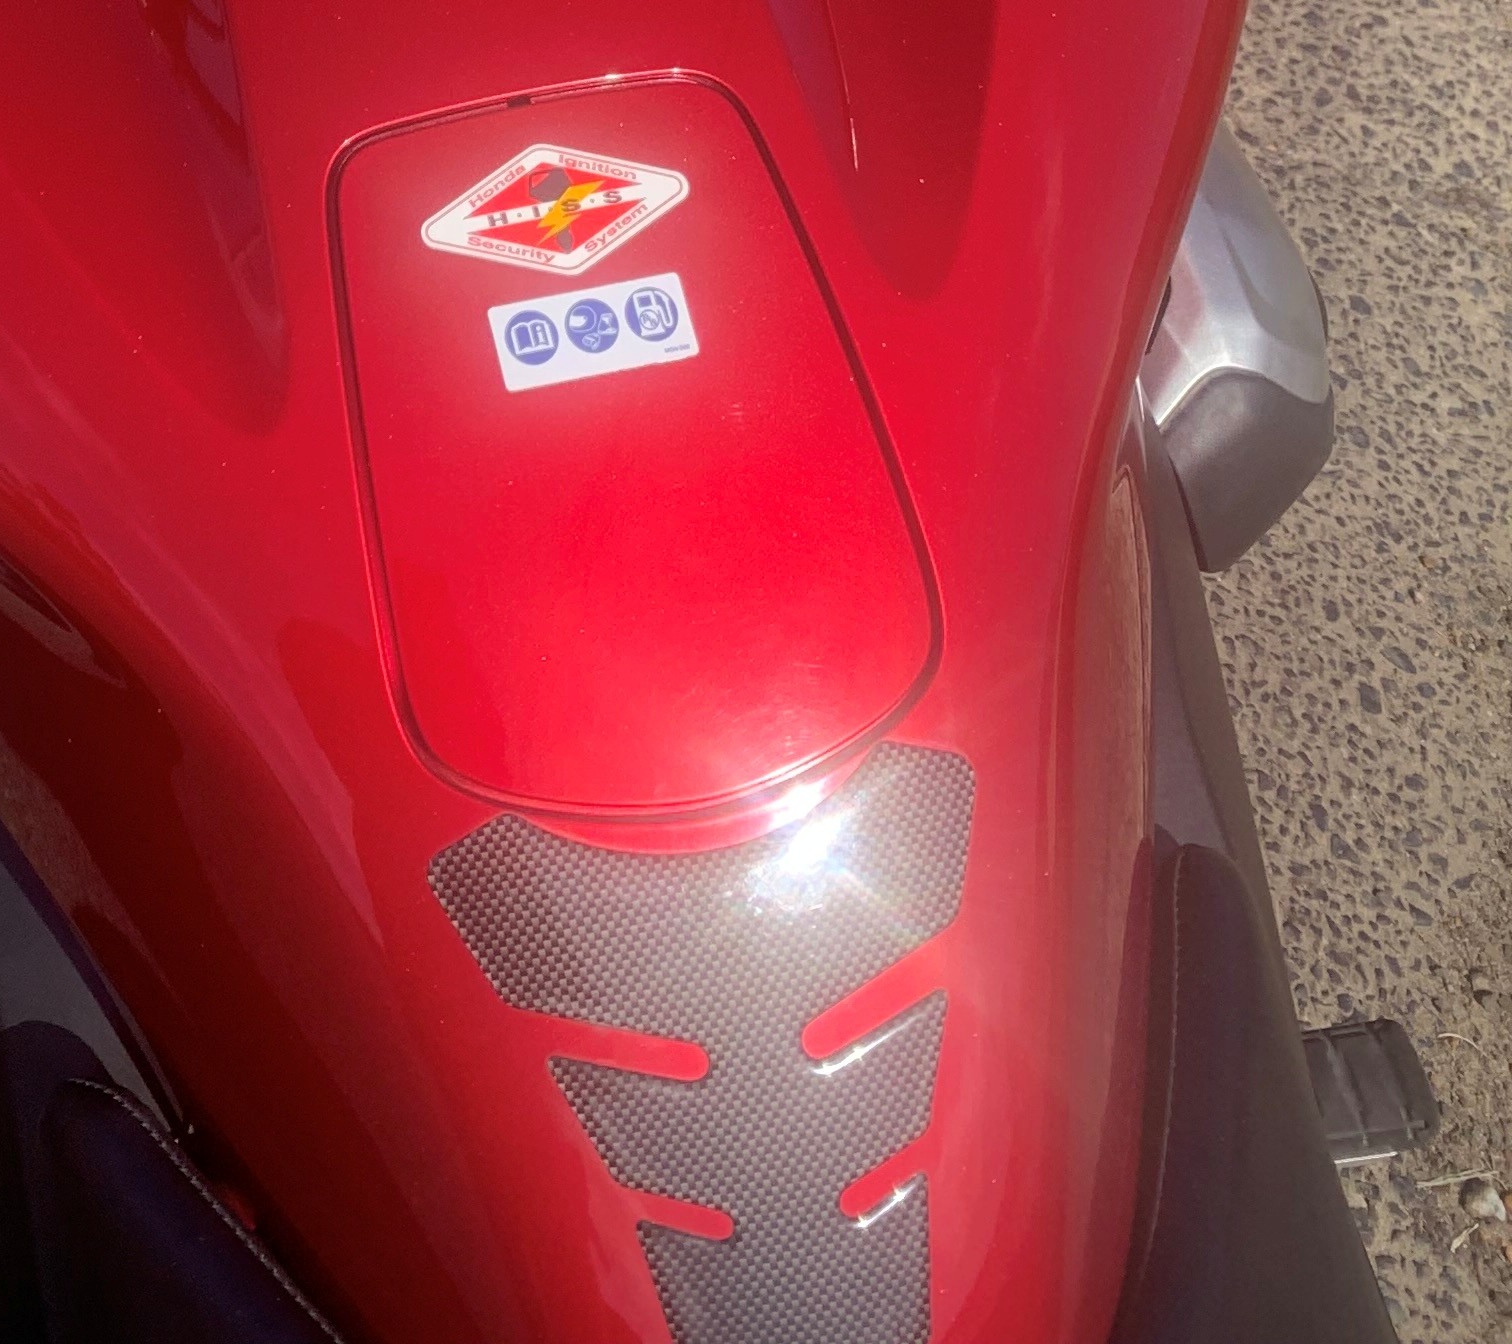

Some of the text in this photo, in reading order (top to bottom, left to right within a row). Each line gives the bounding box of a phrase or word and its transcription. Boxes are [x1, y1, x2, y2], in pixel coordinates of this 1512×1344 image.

[558, 154, 637, 180] Ignition
[468, 164, 526, 209] Honda
[584, 203, 649, 252] System
[466, 235, 556, 263] Security
